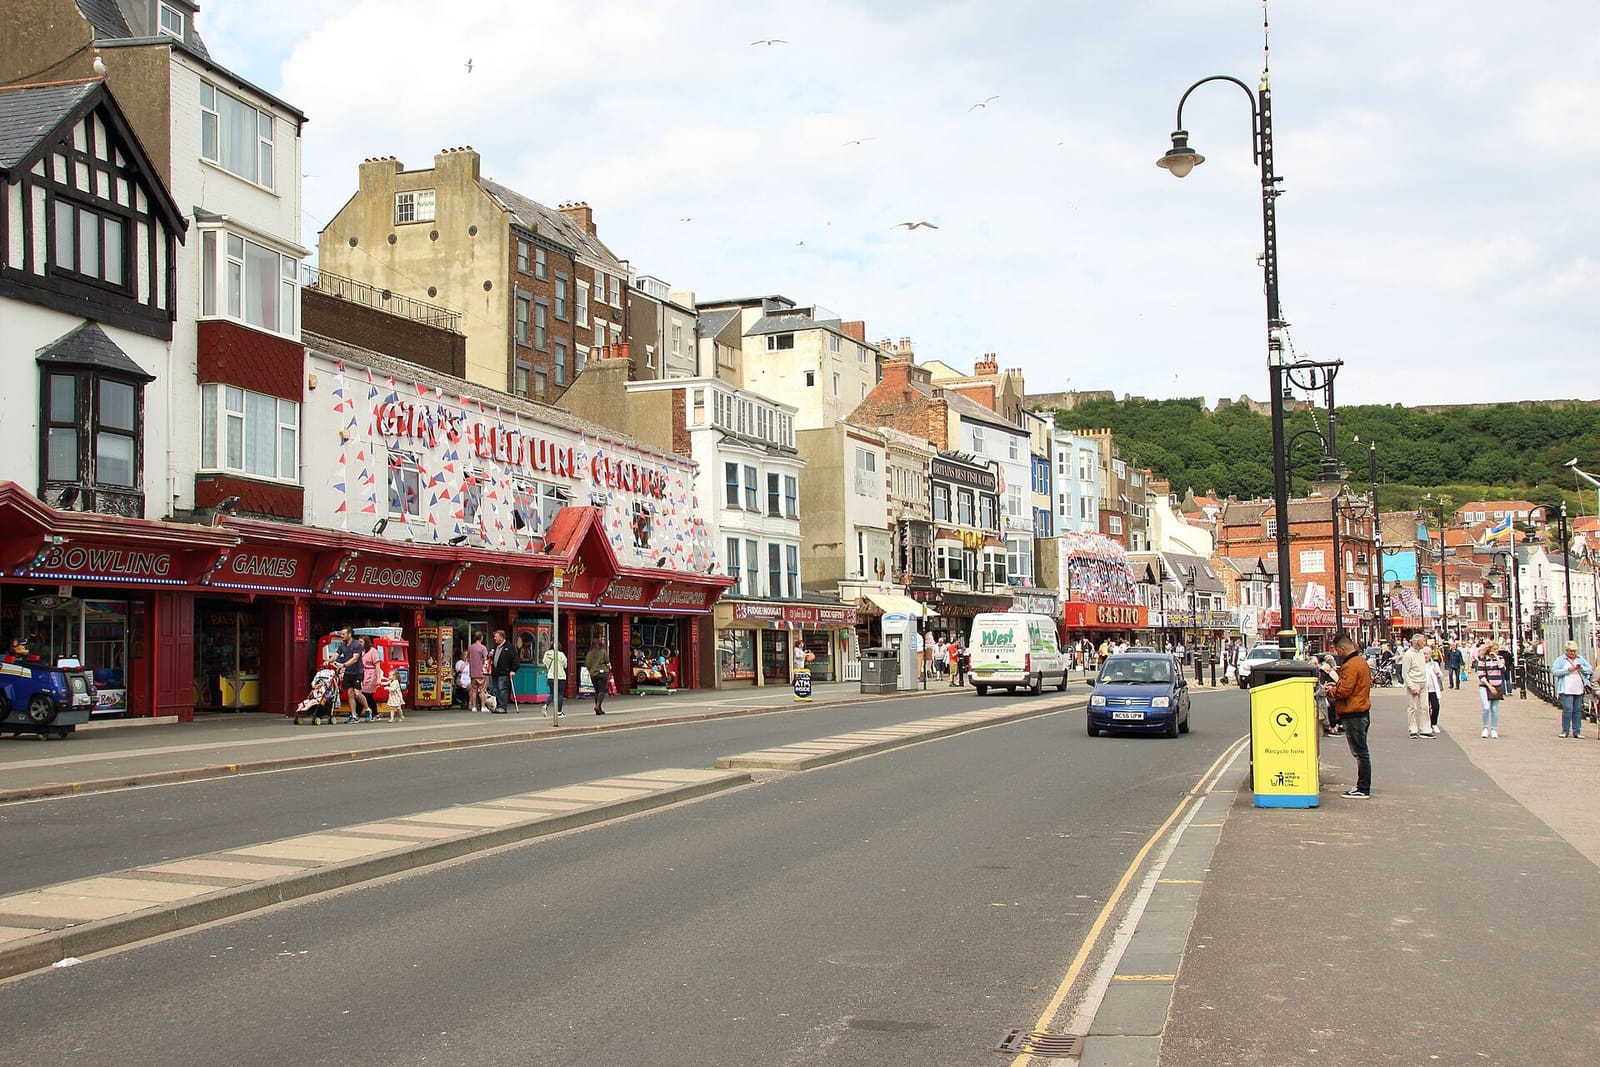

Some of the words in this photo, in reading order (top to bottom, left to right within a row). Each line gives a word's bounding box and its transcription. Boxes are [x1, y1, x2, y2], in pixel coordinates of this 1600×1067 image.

[967, 471, 978, 484] FISH
[982, 475, 995, 488] CHIPS
[46, 547, 171, 575] BOWLING
[232, 554, 298, 578] GAMES
[345, 565, 357, 583] 2
[361, 566, 422, 588] FLOORS
[476, 574, 511, 592] POOL
[1097, 605, 1139, 625] CASINO
[982, 628, 1014, 646] West
